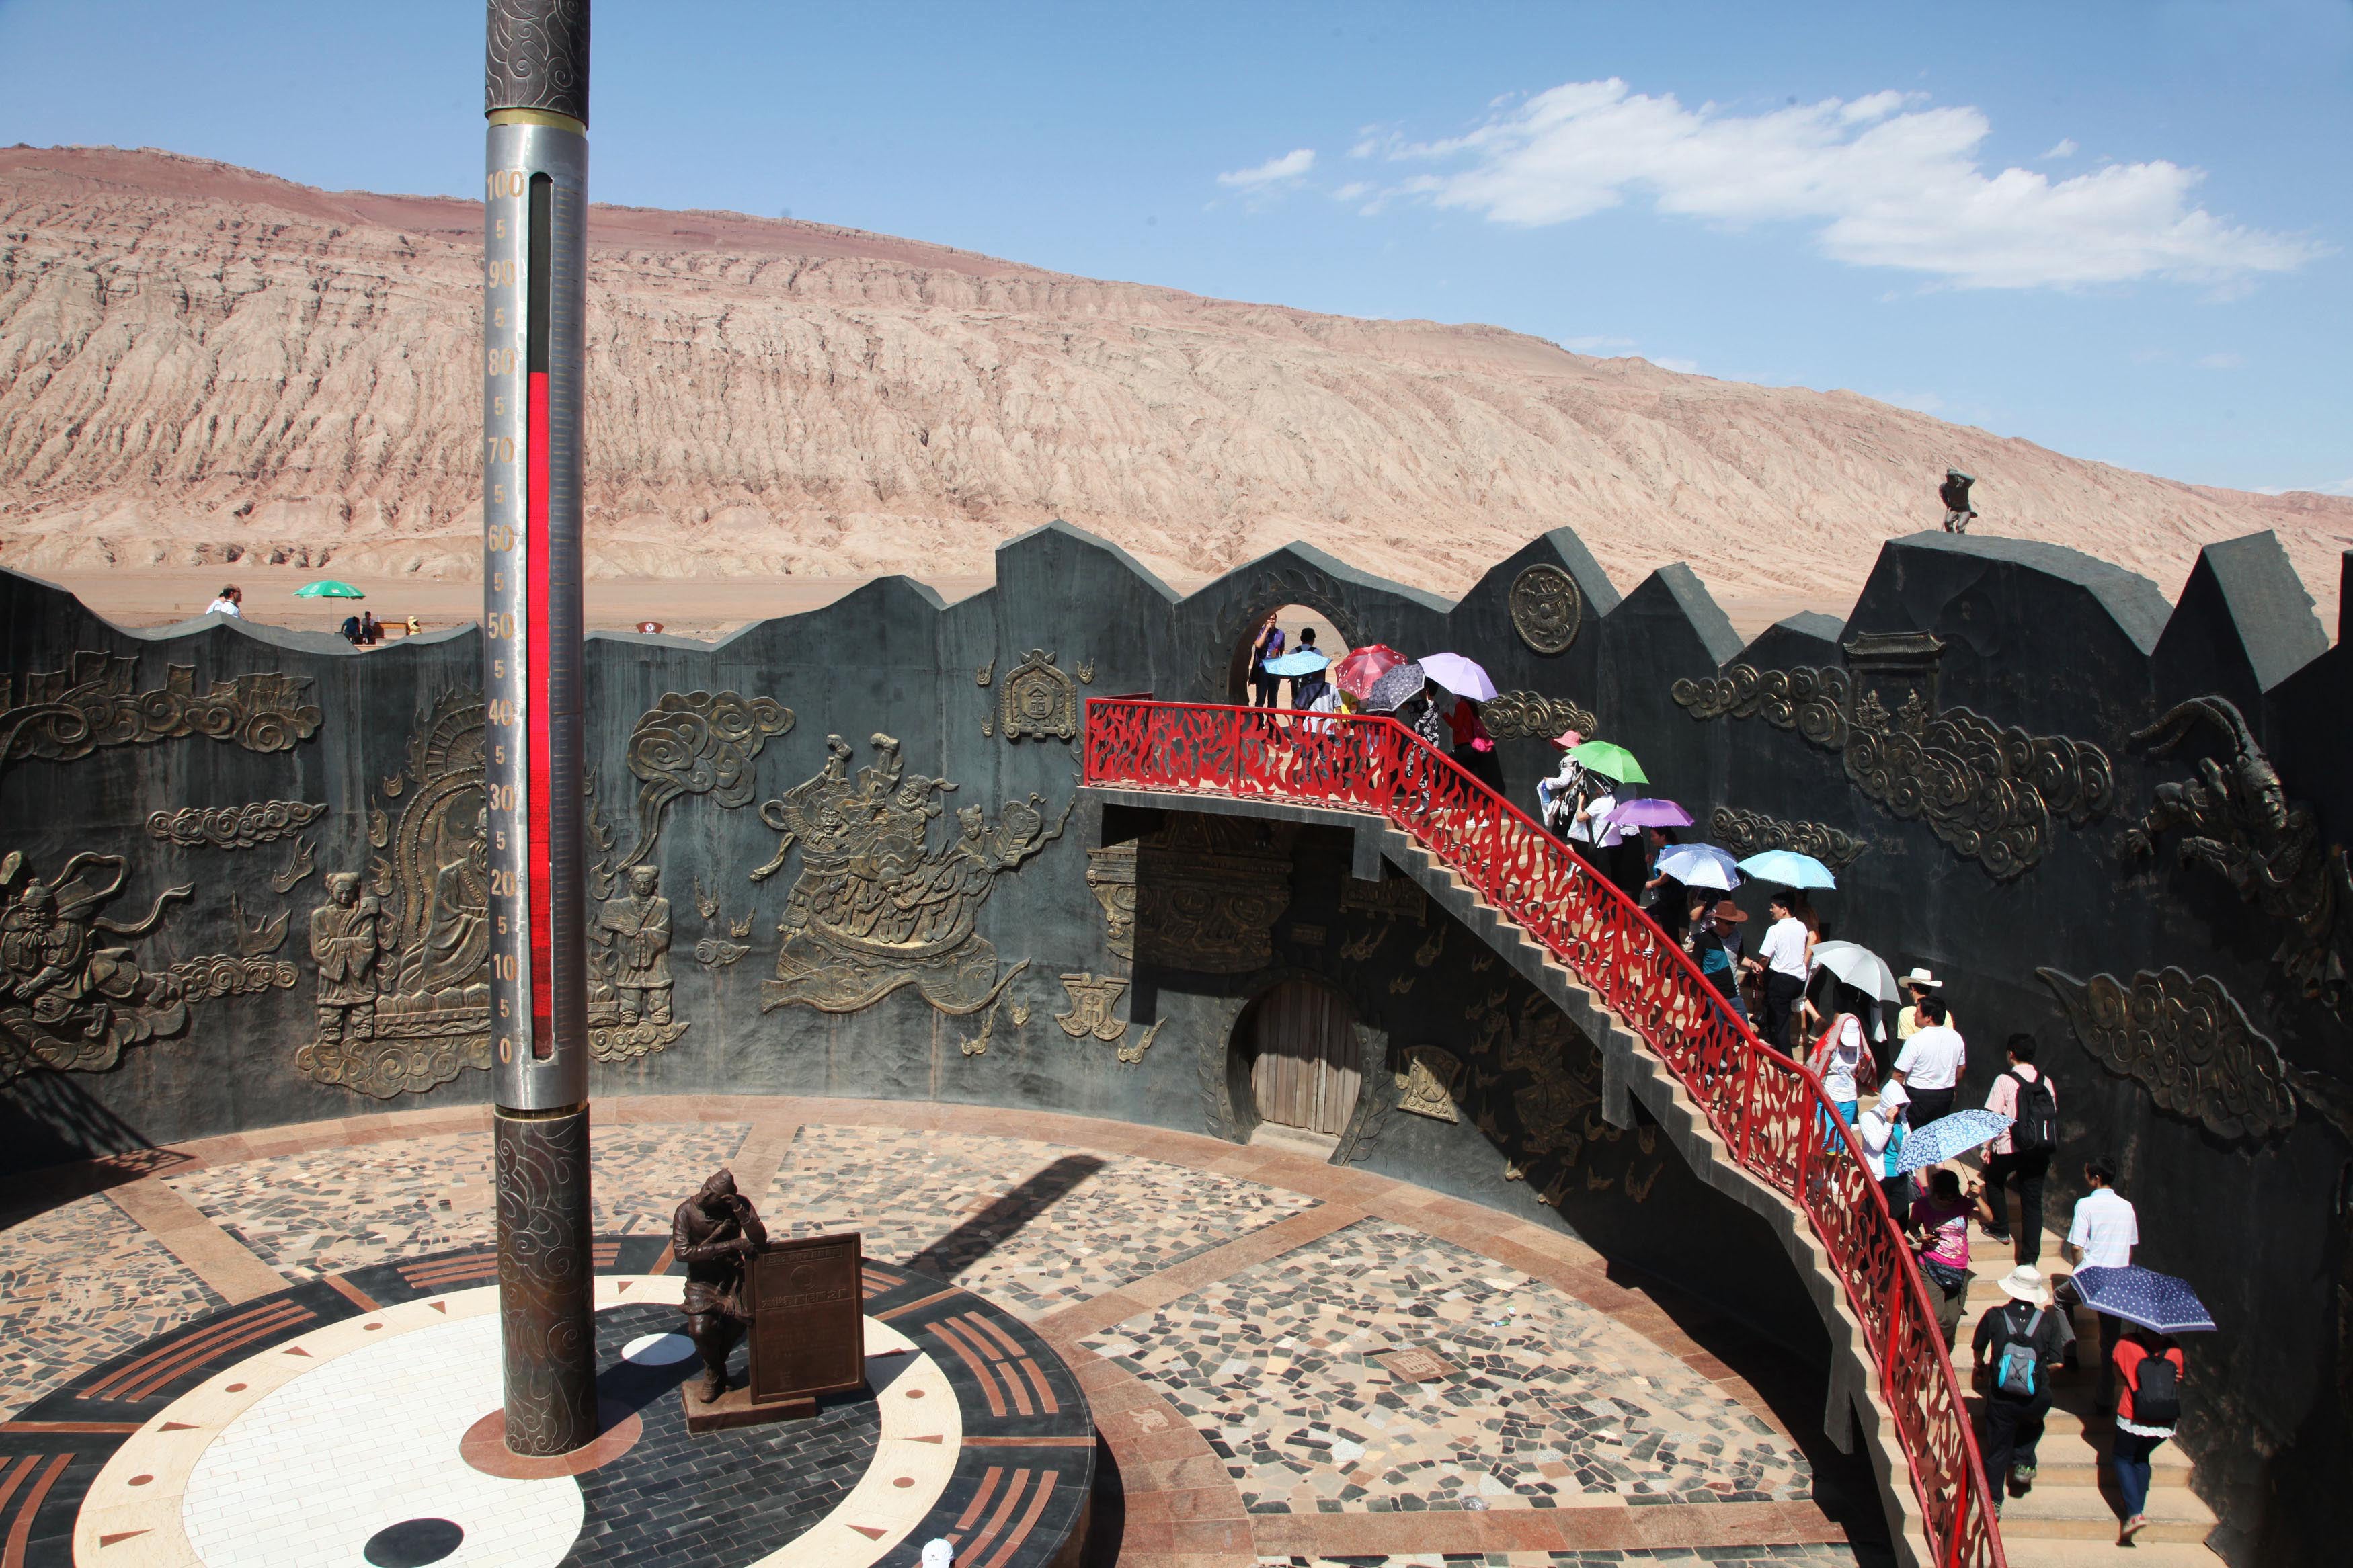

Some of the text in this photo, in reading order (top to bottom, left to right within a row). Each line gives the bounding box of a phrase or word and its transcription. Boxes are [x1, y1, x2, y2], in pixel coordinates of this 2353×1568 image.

[487, 171, 525, 202] 100
[495, 218, 506, 239] 5
[489, 259, 516, 288] 90
[495, 308, 505, 328] 5
[489, 347, 515, 376] 80
[495, 397, 505, 416] 5
[489, 436, 514, 464] 70
[495, 484, 505, 504] 5
[489, 524, 514, 552] 60
[494, 572, 504, 592] 5
[489, 612, 514, 639] 50
[495, 659, 505, 679] 5
[489, 698, 514, 727] 40
[495, 745, 506, 764] 5
[490, 783, 515, 811] 30
[495, 831, 506, 850] 5
[491, 868, 516, 897] 20
[497, 915, 507, 935] 5
[493, 953, 517, 981] 10
[500, 999, 510, 1018] 5
[500, 1037, 512, 1065] 0
